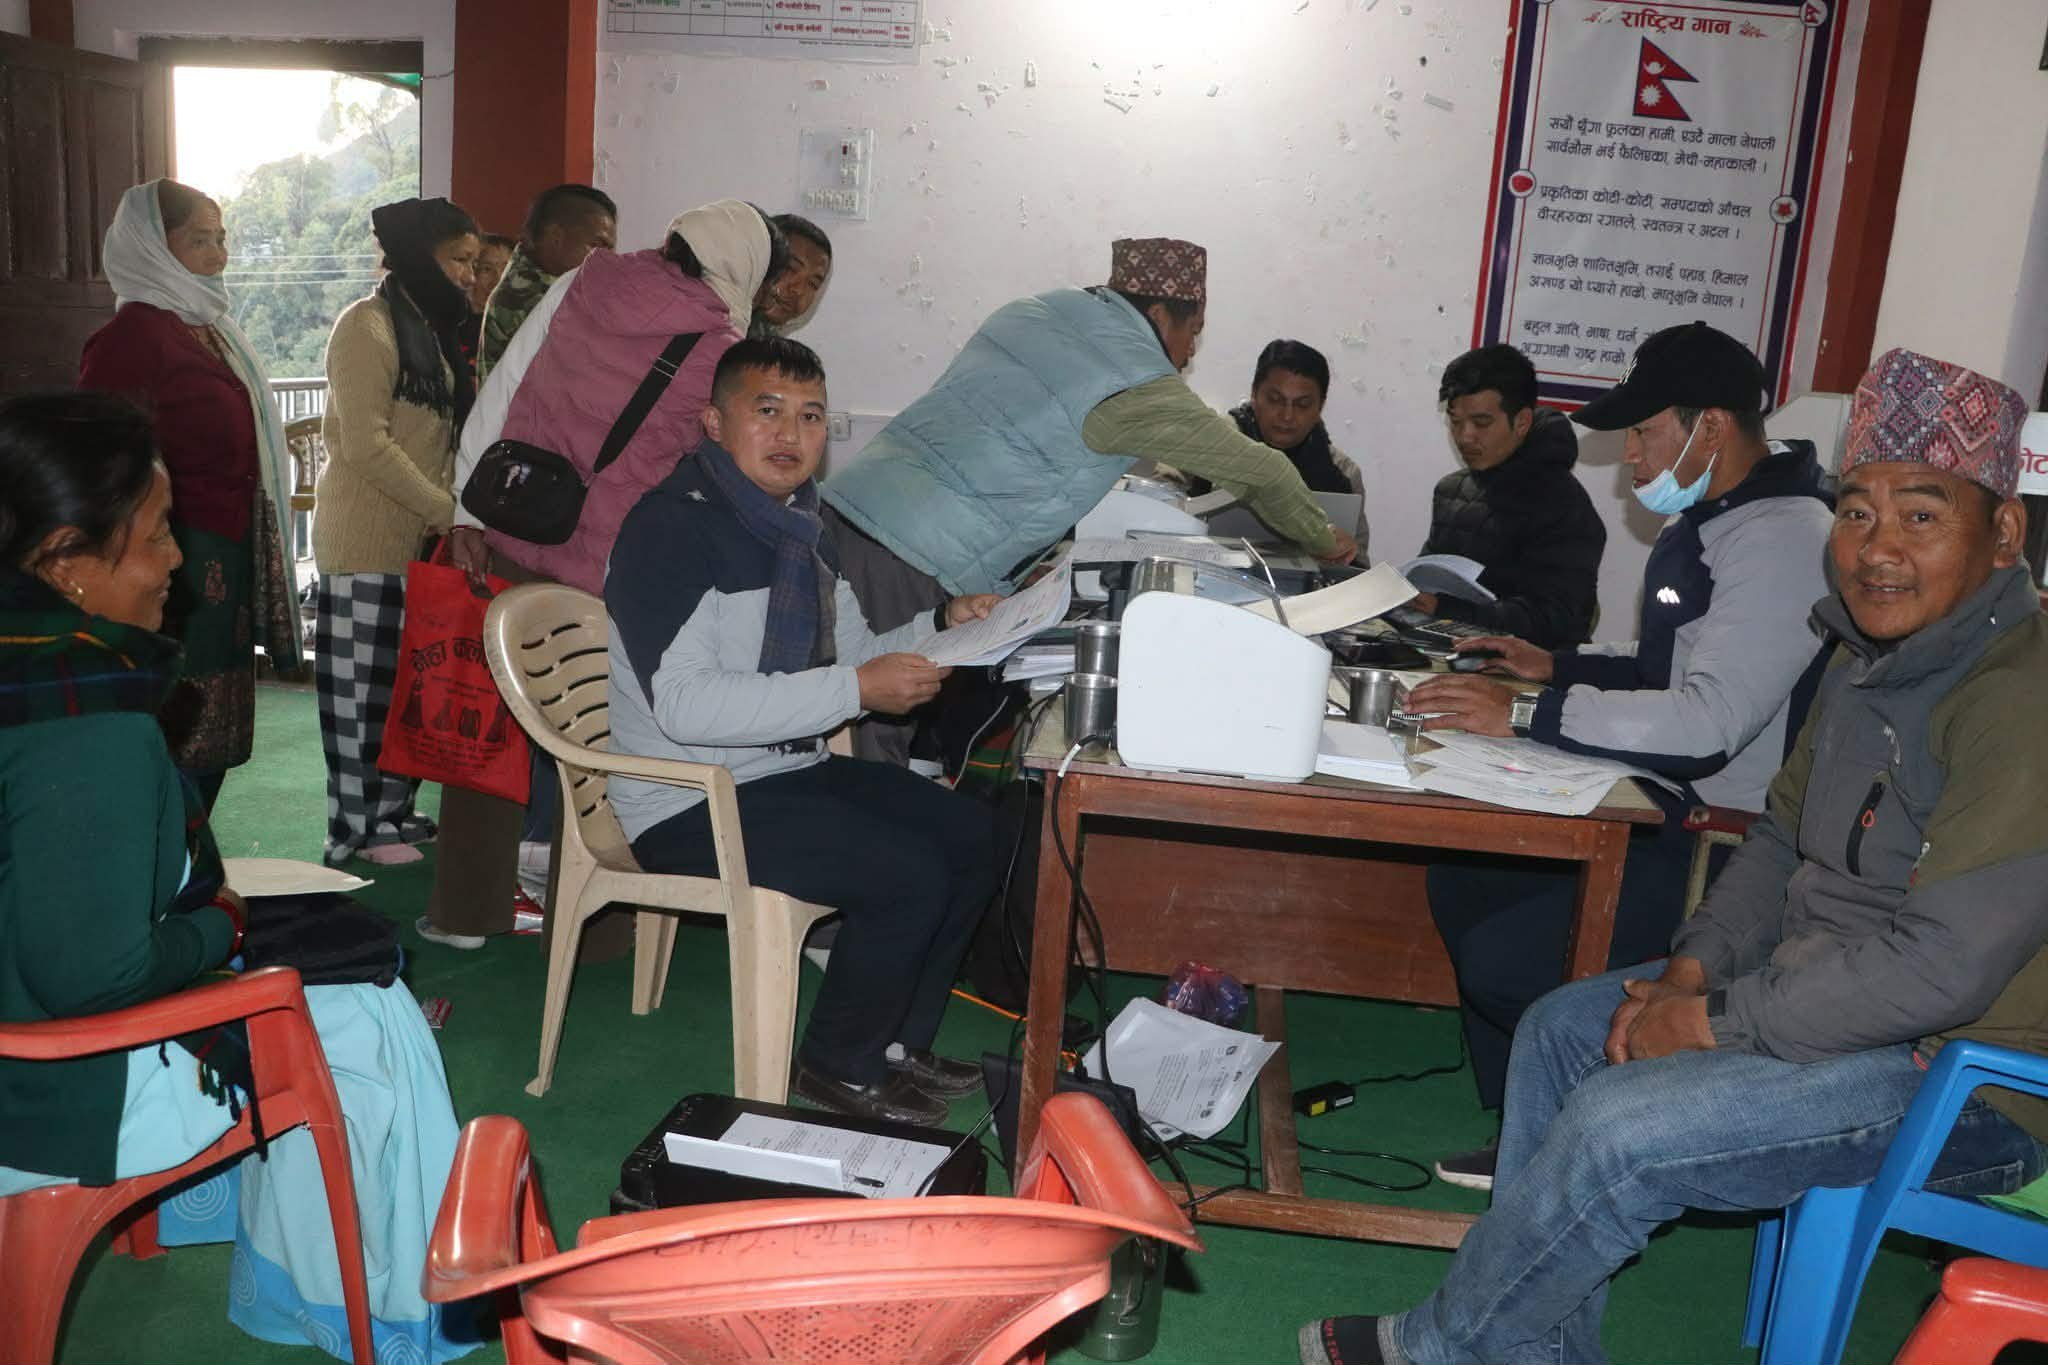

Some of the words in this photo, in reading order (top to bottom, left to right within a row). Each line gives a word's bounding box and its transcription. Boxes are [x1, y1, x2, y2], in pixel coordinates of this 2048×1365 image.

[1621, 8, 1686, 33] राष्ट्रिय
[1692, 17, 1733, 35] गान
[1707, 132, 1738, 146] माला
[1739, 131, 1776, 150] नेपाली
[1540, 185, 1589, 201] प्रकृतिका
[1660, 198, 1714, 213] सम्पदाको
[1642, 219, 1684, 234] स्वतन्त्र
[1688, 223, 1696, 236] र
[1699, 224, 1730, 239] अटल
[1712, 269, 1749, 287] हिमाल
[1529, 274, 1565, 290] अखण्ड
[1569, 276, 1583, 291] यो
[1587, 280, 1617, 296] प्यारो
[1702, 290, 1734, 308] नेपाल
